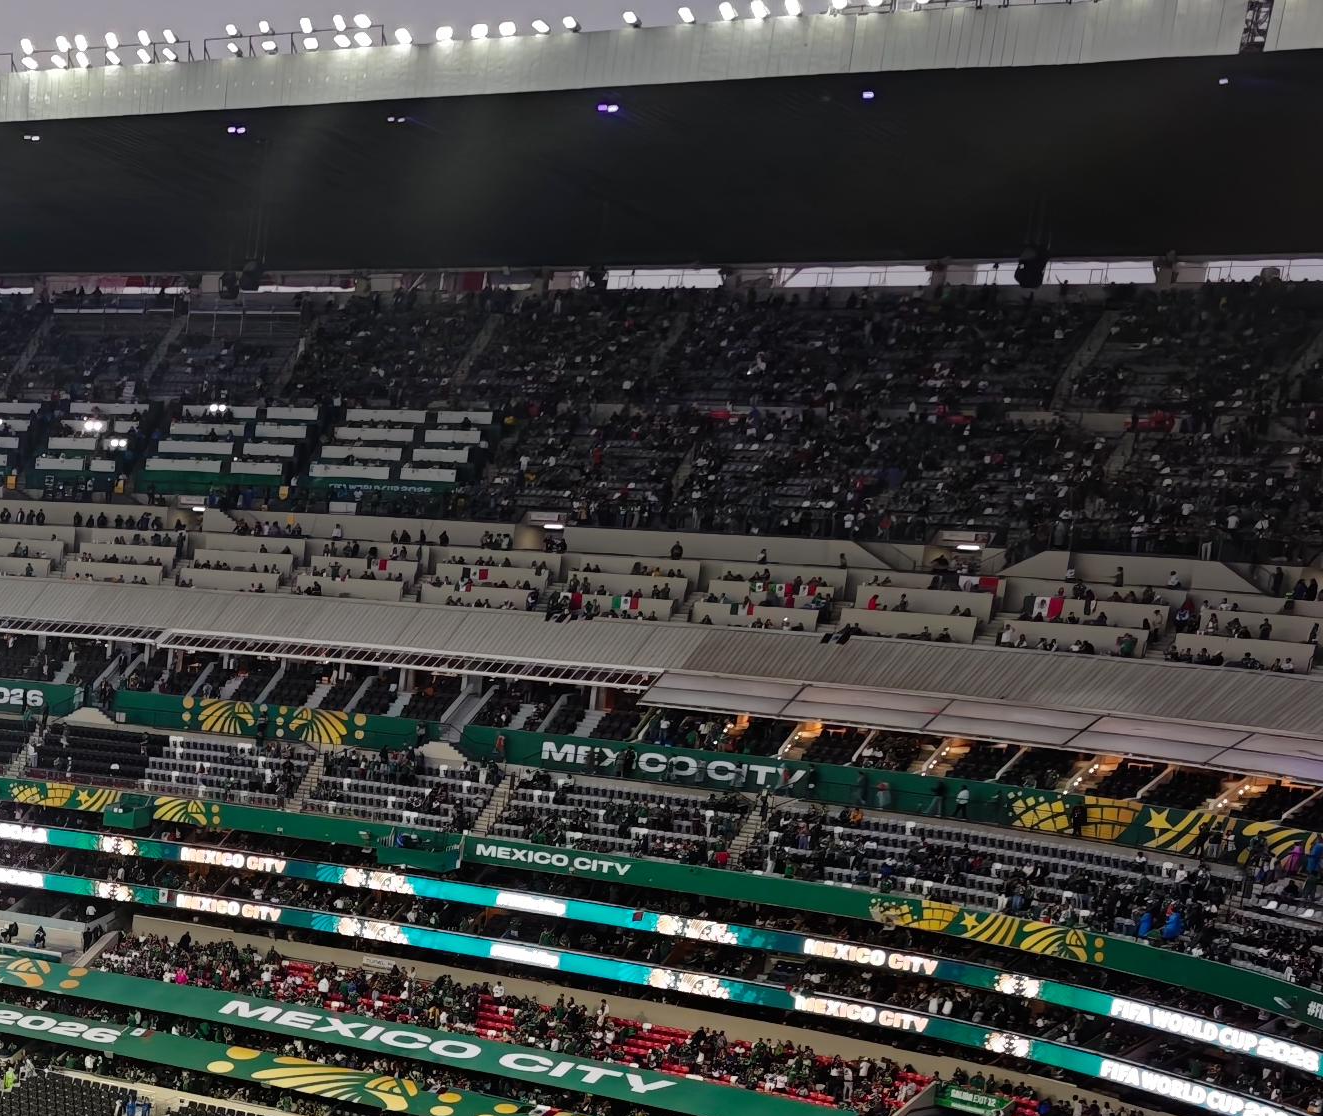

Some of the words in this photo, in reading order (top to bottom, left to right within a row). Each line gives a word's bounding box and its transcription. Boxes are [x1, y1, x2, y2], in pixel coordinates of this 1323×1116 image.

[475, 843, 570, 868] MEXICO
[573, 856, 632, 876] CITY
[804, 938, 886, 966] MEXICO
[887, 952, 939, 976] CITY
[795, 995, 877, 1024] MEXICO
[878, 1009, 930, 1034] CITY
[1110, 998, 1151, 1025] FIFA
[1151, 1007, 1219, 1042] WORLD
[1219, 1023, 1258, 1051] CUP
[218, 999, 489, 1059] MEXICO
[498, 1052, 678, 1095] CITY
[974, 1094, 988, 1105] EXIT
[1099, 1058, 1140, 1086] FIFA
[1141, 1069, 1207, 1104] WORLD
[1206, 1087, 1244, 1115] CUP
